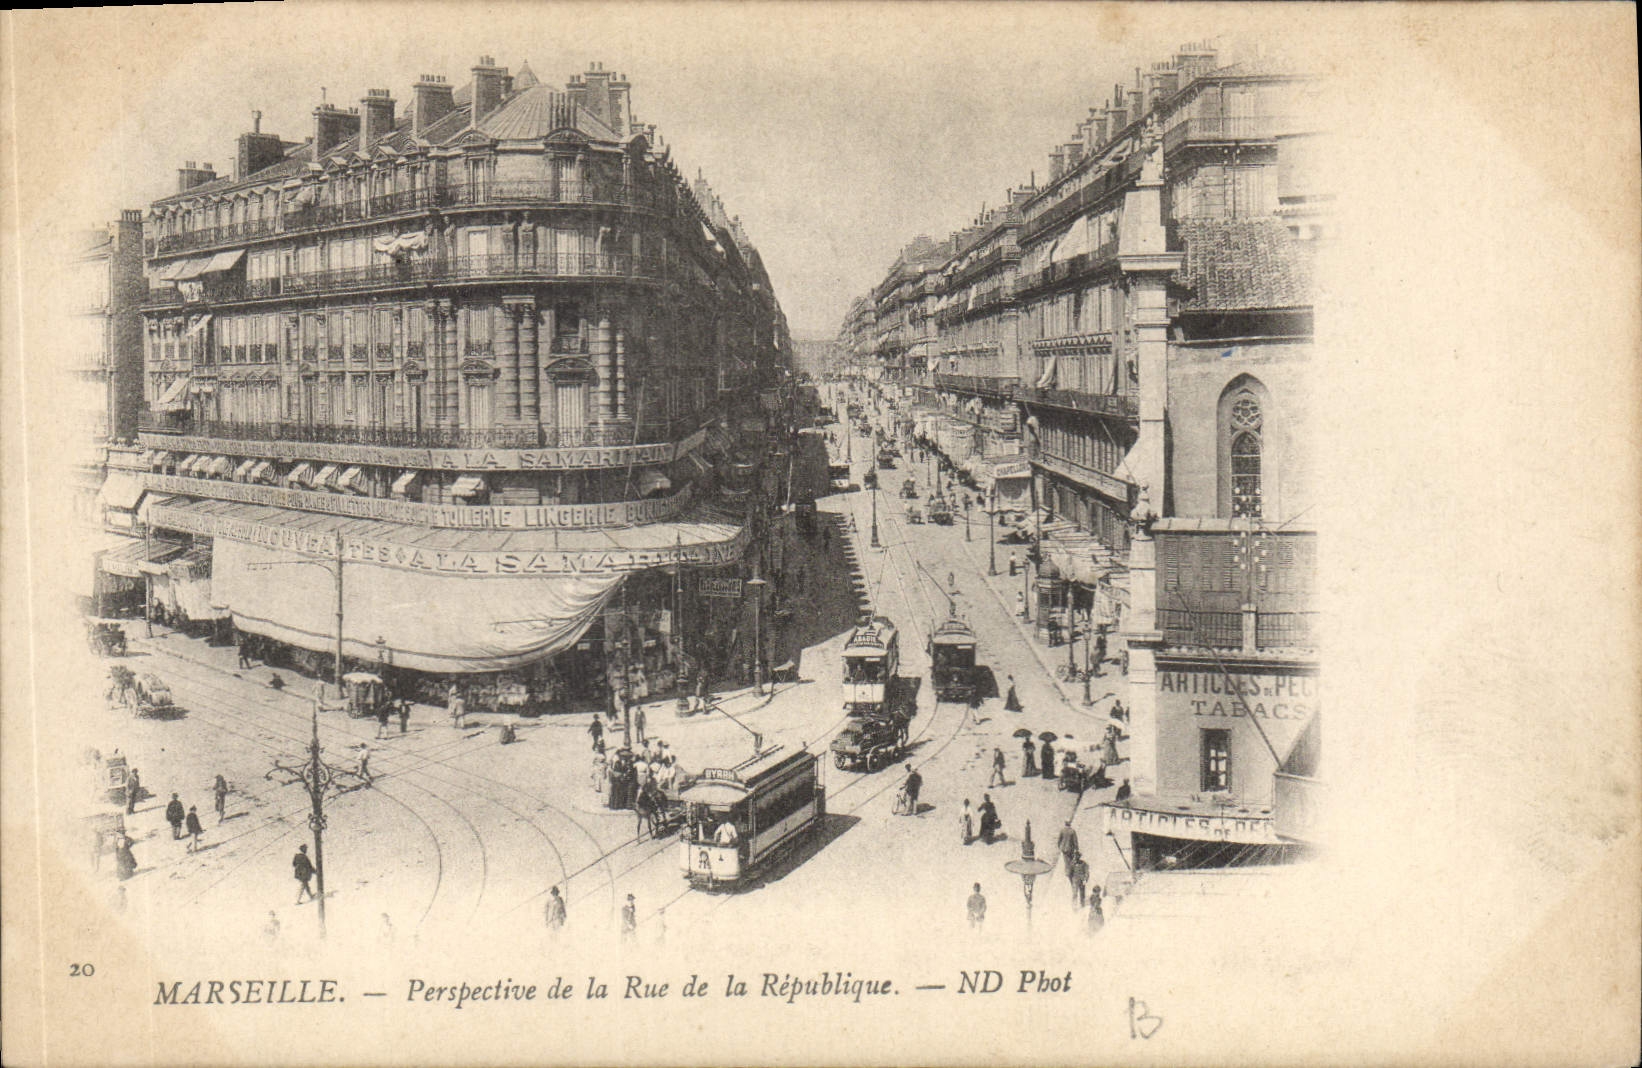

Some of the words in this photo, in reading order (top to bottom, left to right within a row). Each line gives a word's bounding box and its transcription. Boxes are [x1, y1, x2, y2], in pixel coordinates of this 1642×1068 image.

[464, 452, 507, 469] LA
[524, 507, 616, 528] LINGERIE
[1160, 672, 1262, 697] ARTICLES
[1190, 699, 1307, 721] TABACS
